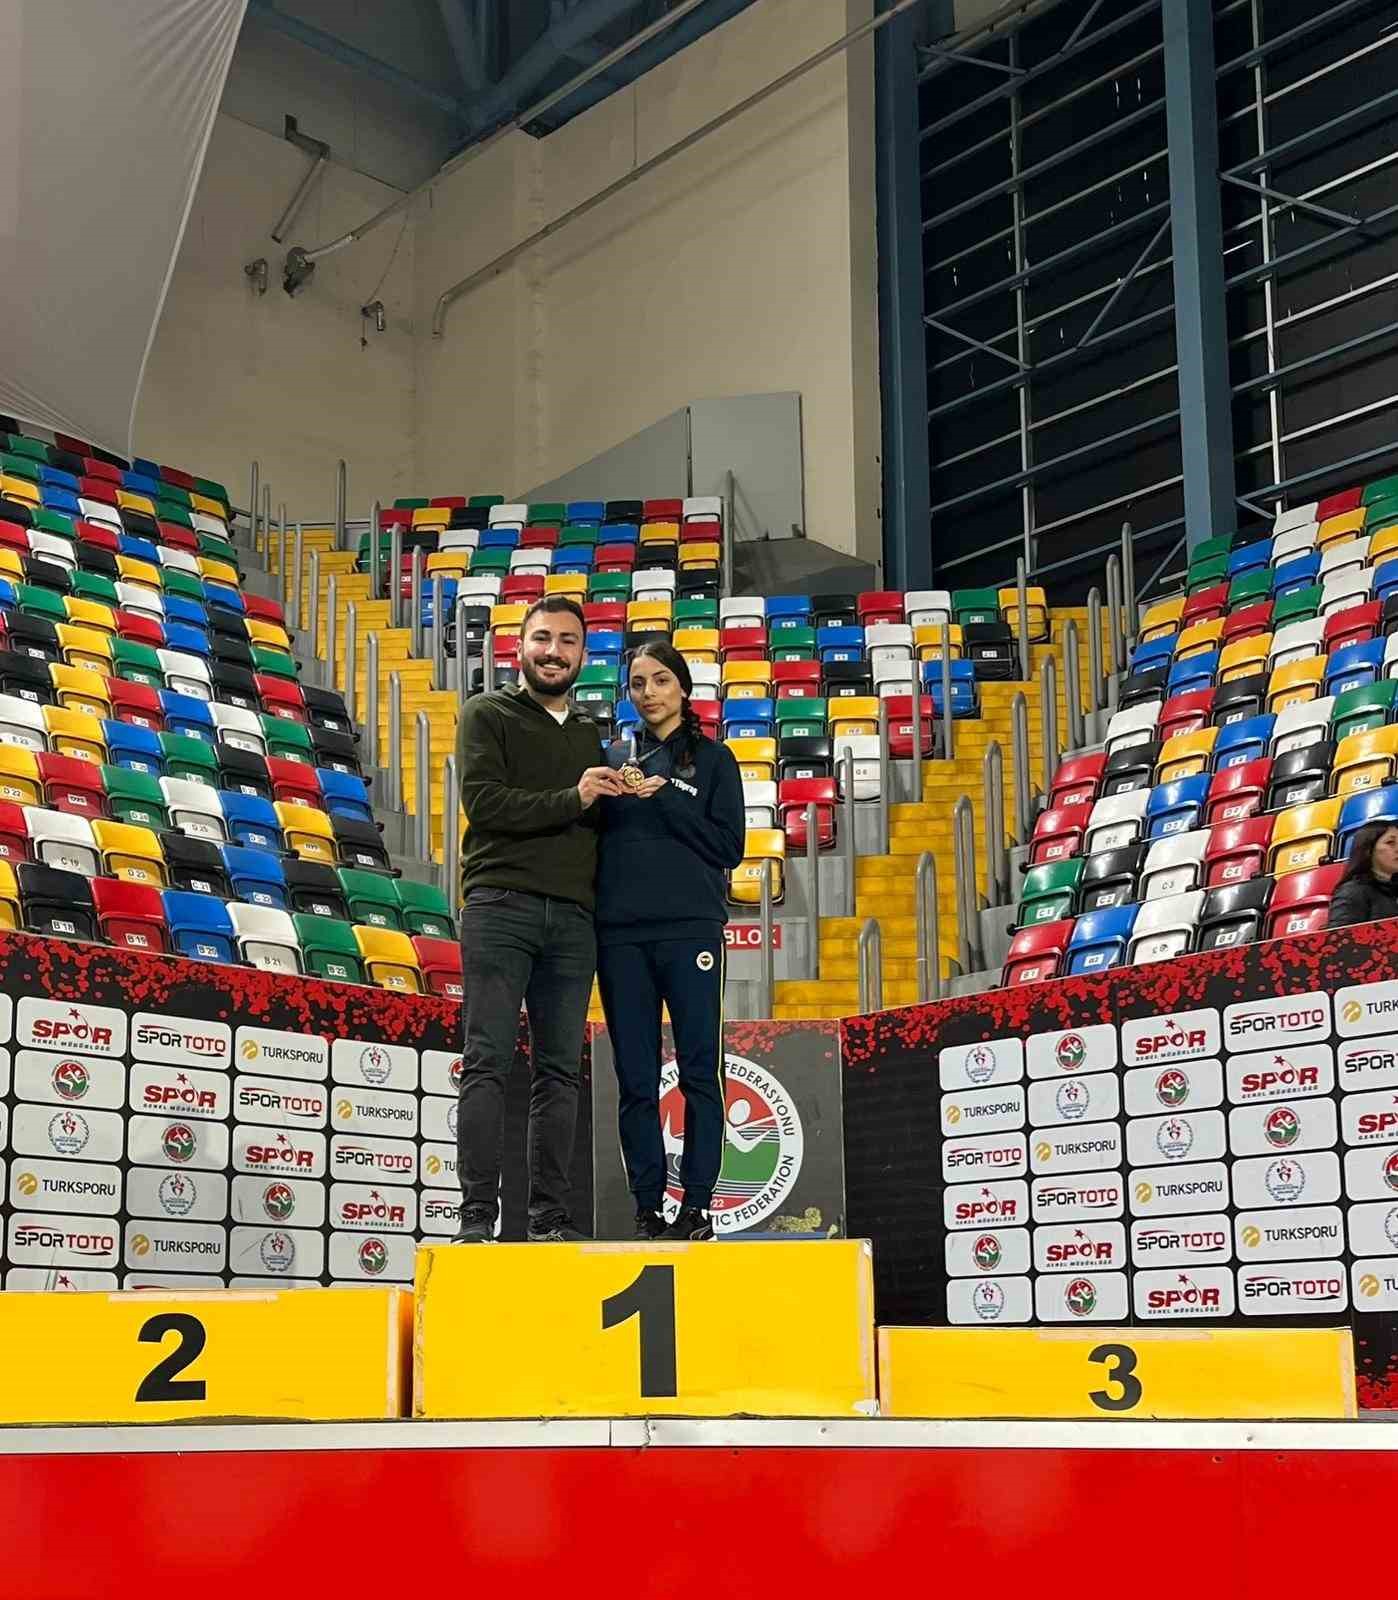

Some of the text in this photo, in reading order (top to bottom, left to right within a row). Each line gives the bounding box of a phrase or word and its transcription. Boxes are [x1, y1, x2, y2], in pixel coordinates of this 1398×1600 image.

[32, 1019, 112, 1045] SPOR
[1135, 1030, 1206, 1055] SPOR
[262, 1046, 323, 1064] TURKSPORU
[1241, 1067, 1318, 1092] SPOR
[144, 1085, 217, 1107] SPOR
[355, 1105, 413, 1122] TURKSPORU
[964, 1101, 1021, 1117] TURKSPORU
[245, 1146, 314, 1167] SPOR
[1055, 1139, 1116, 1156] TURKSPORU
[42, 1179, 116, 1196] TURKSPORU
[735, 1155, 795, 1223] FEDERATION
[1156, 1180, 1223, 1197] TURKSPORU
[342, 1203, 405, 1222] SPOR
[956, 1200, 1017, 1219] SPOR
[1265, 1225, 1337, 1241] TURKSPORU
[153, 1239, 221, 1255] TURKSPORU
[1046, 1242, 1112, 1261] SPOR
[1148, 1288, 1220, 1309] SPOR
[603, 1265, 676, 1397] 1
[136, 1313, 205, 1401] 2
[1089, 1344, 1141, 1410] 3
